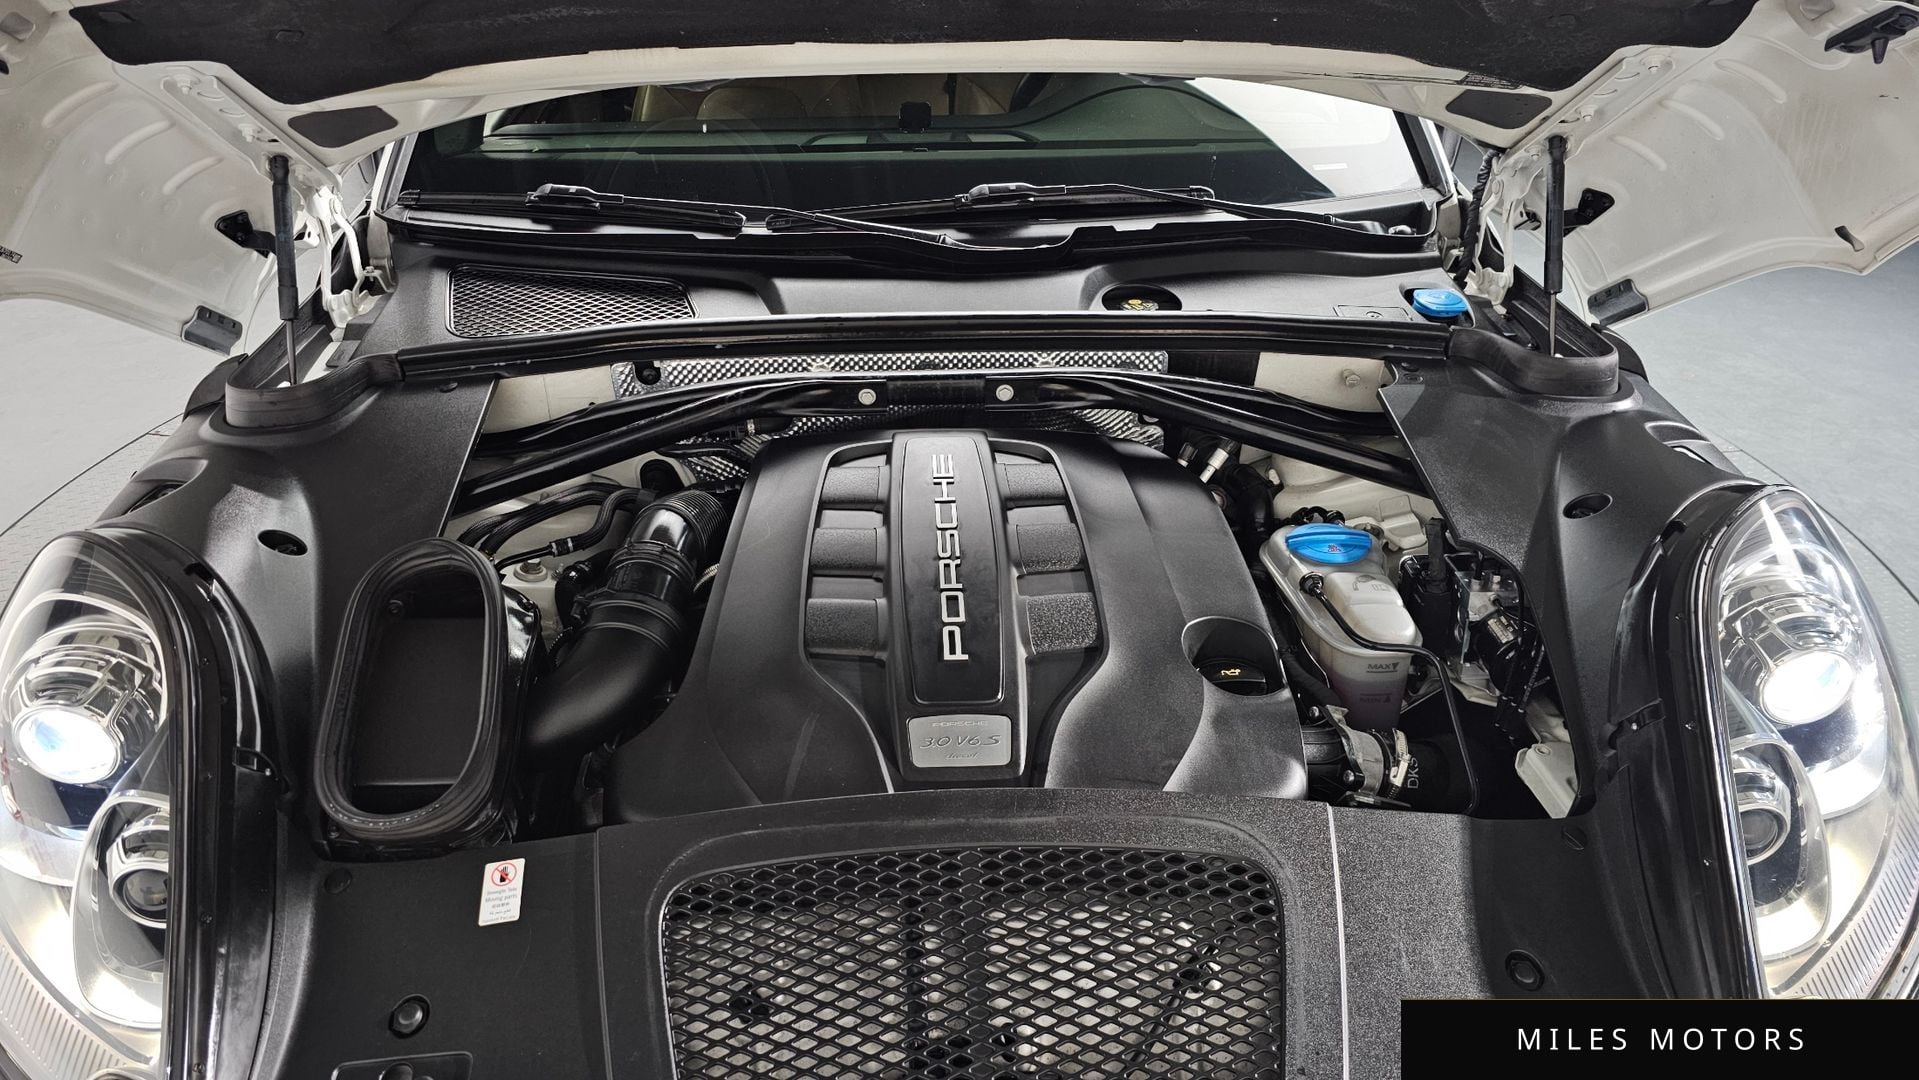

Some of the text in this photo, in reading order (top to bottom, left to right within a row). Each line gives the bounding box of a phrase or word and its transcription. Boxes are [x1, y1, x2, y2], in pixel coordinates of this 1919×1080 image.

[932, 454, 969, 661] PORSCHE
[919, 734, 1002, 749] 3.0 V6 S
